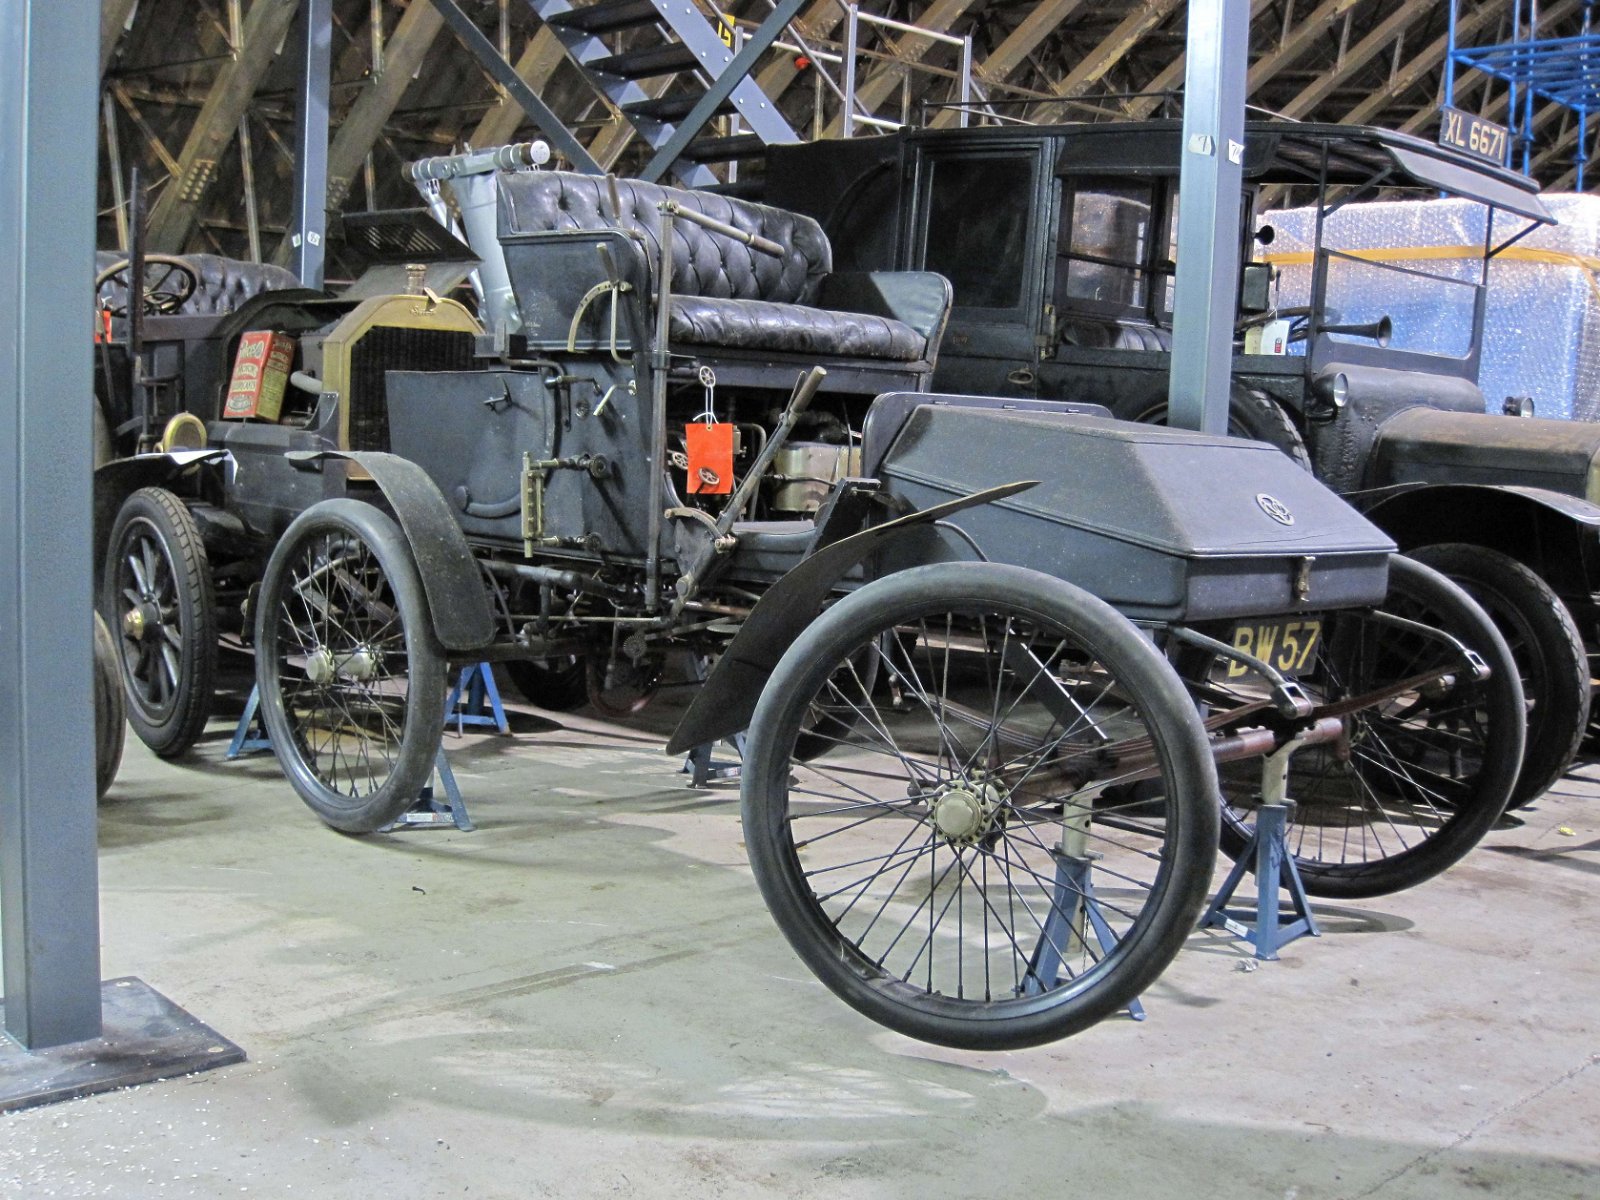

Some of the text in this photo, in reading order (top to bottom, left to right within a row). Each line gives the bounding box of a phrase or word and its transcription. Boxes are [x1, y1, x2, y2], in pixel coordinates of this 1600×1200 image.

[1445, 111, 1505, 160] XL 6671
[1228, 620, 1321, 677] BW 57
